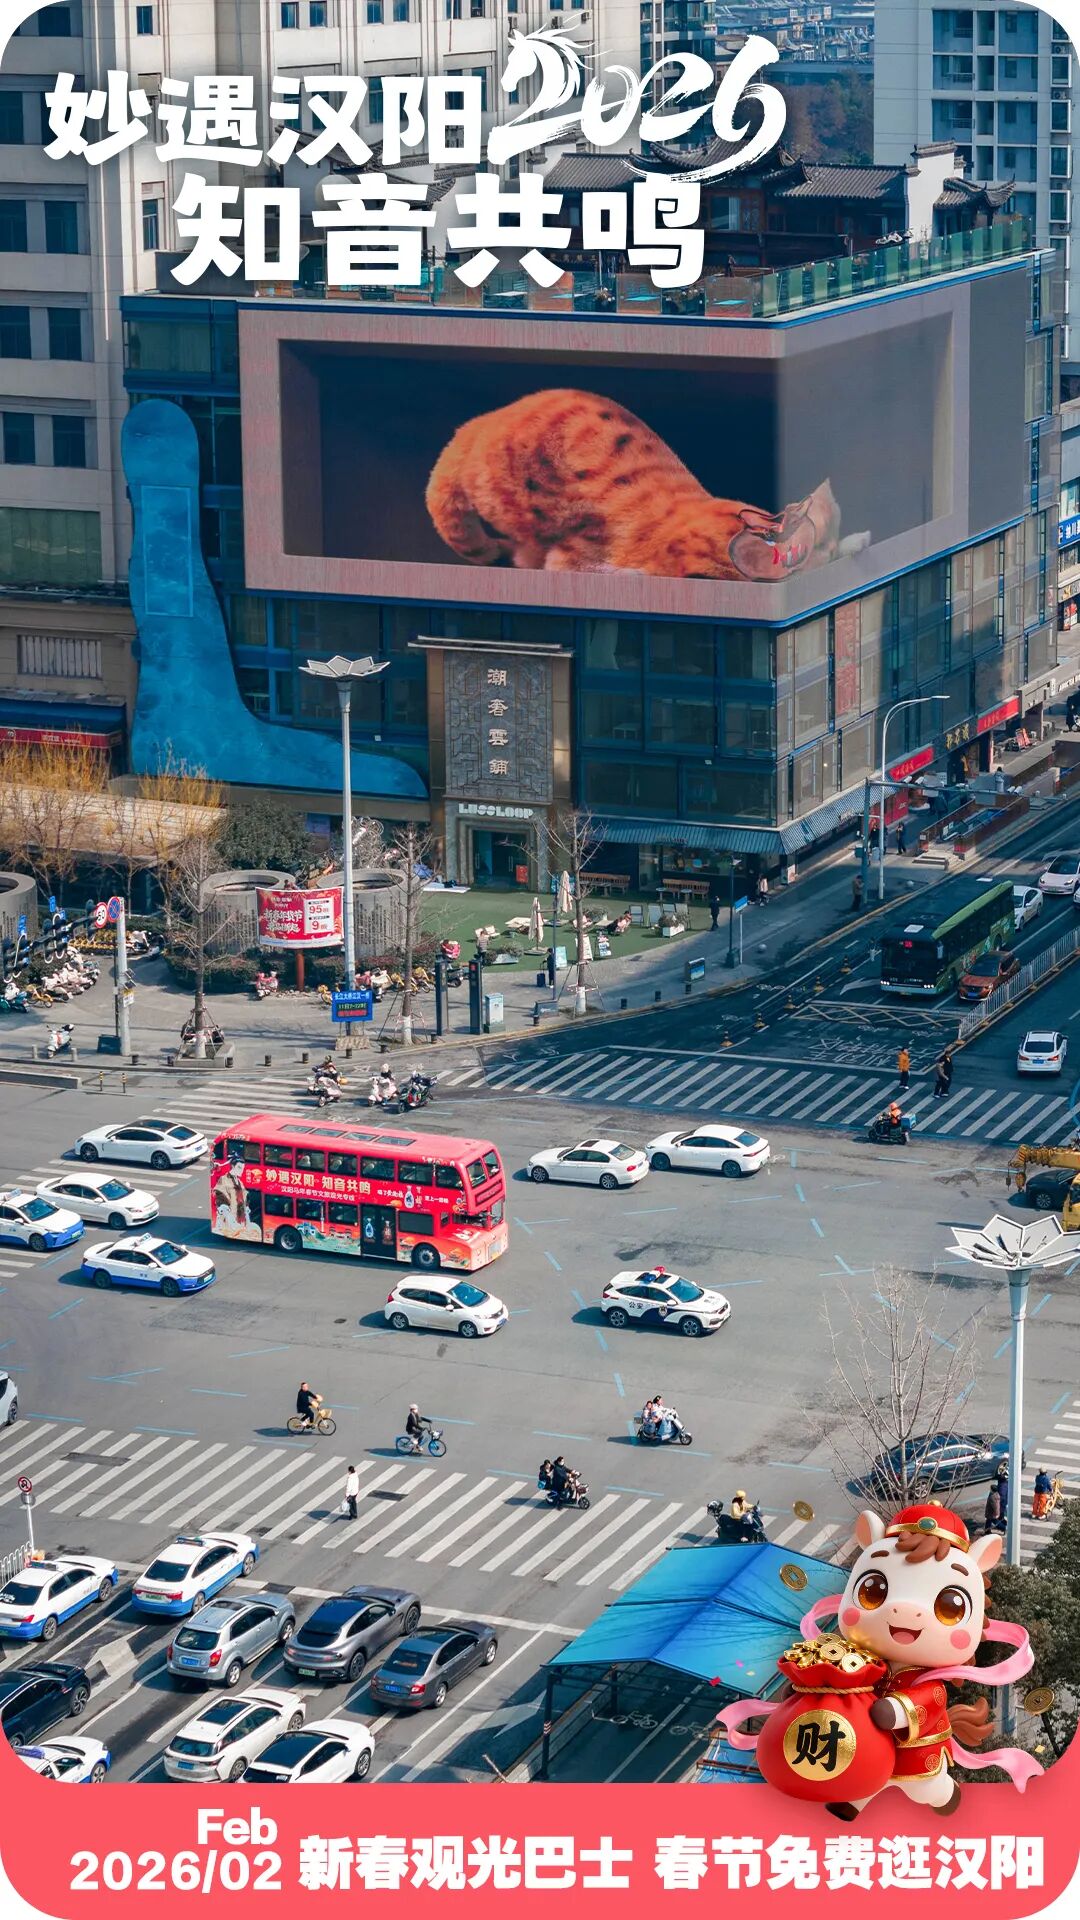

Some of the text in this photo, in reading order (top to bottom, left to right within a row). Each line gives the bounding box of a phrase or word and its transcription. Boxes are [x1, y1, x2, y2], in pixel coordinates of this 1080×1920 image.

[265, 1168, 315, 1187] 妙遇汉阳
[321, 1175, 371, 1195] 知音共鸣
